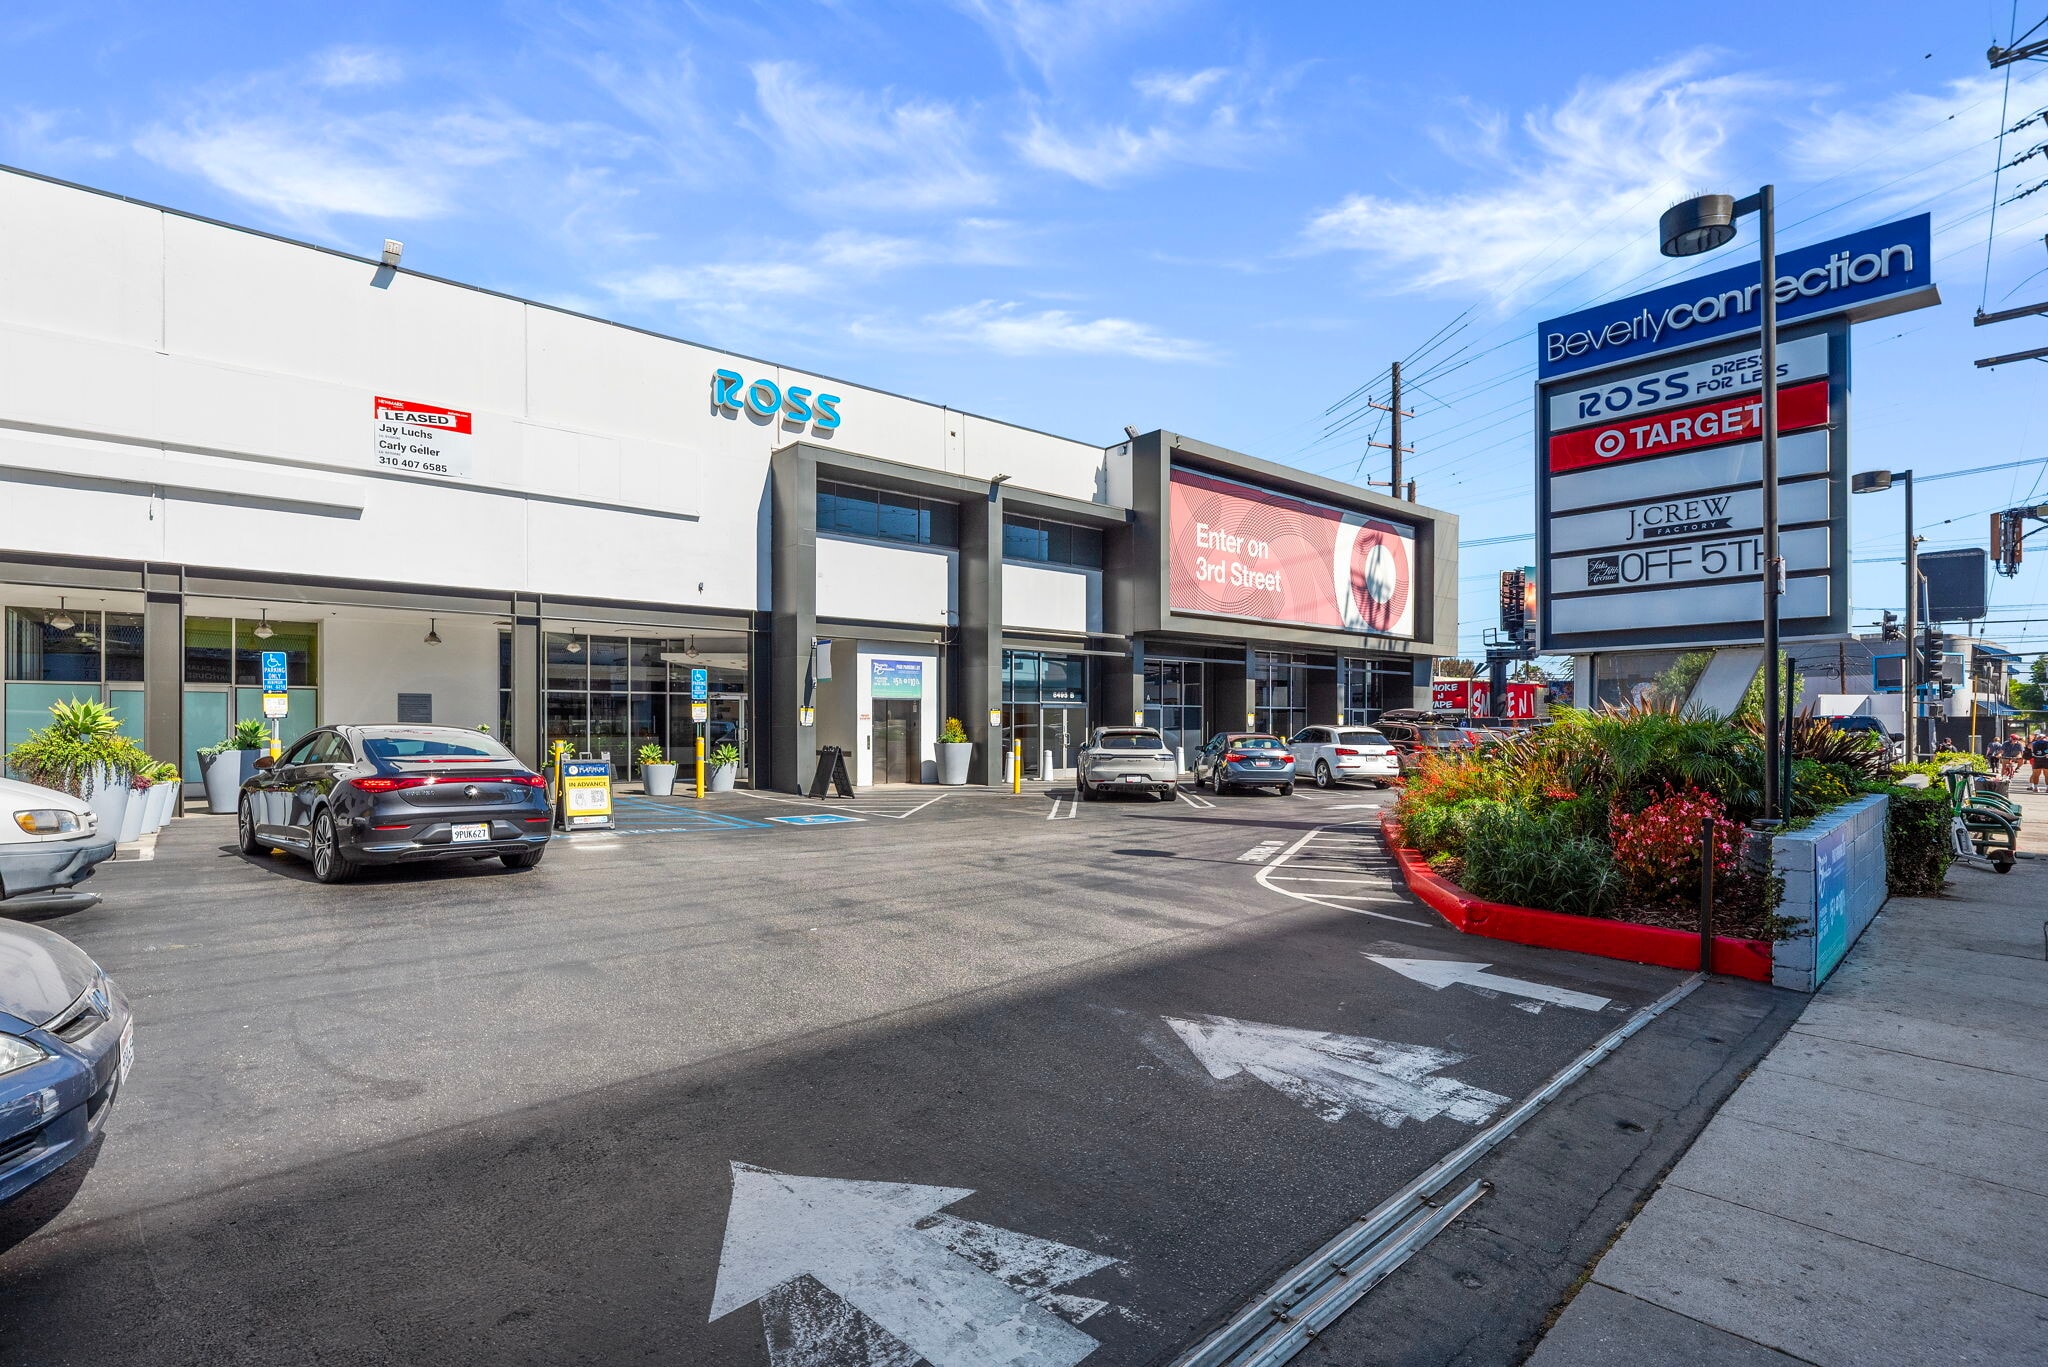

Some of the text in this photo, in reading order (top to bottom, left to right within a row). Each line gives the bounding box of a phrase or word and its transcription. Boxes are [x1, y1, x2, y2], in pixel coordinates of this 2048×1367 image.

[1696, 363, 1789, 394] FOR LES
[714, 368, 842, 430] ROSS
[1579, 371, 1689, 419] ROSS
[379, 424, 398, 436] Jay
[402, 426, 433, 440] Luchs
[384, 412, 449, 425] LEASED
[1629, 402, 1763, 450] TARGET
[379, 440, 406, 453] Carly
[410, 444, 440, 456] Geller
[379, 456, 448, 472] 310 407 6585
[1626, 496, 1732, 540] J.CREW
[1657, 522, 1717, 535] FACTORY
[1196, 522, 1268, 559] Enter on
[1196, 556, 1282, 592] 3rd Street
[1621, 546, 1692, 582] OFF
[1432, 700, 1453, 708] APE
[455, 829, 486, 839] 9PUK627
